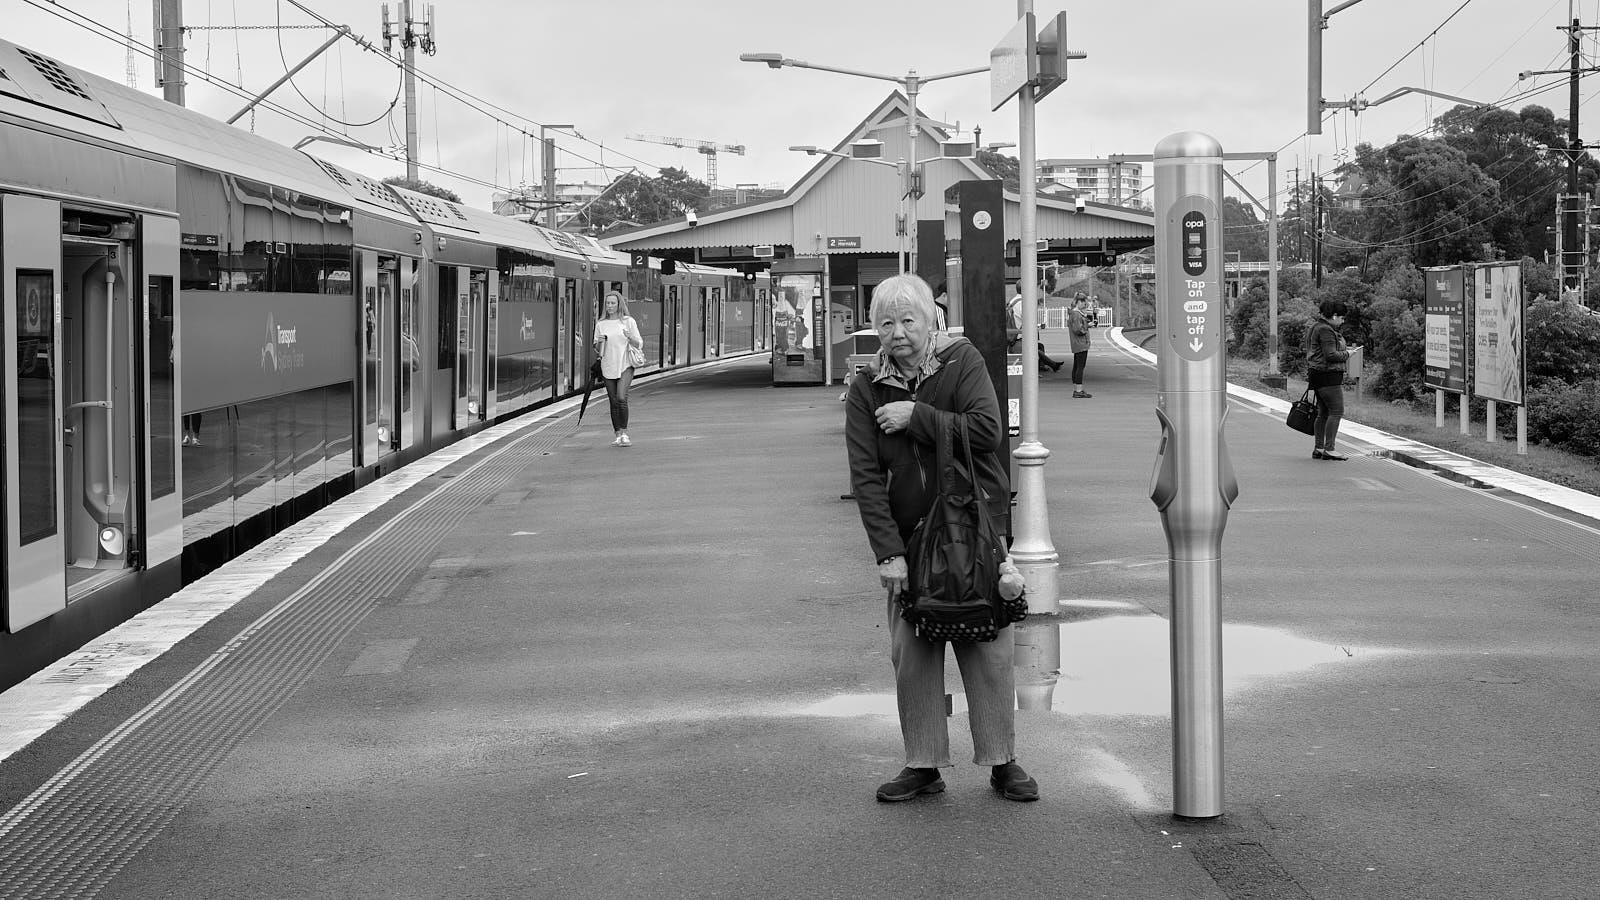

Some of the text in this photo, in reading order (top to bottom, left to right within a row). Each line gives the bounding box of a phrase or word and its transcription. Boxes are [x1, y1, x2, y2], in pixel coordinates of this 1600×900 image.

[1185, 220, 1203, 229] opal
[830, 239, 836, 247] 2
[110, 251, 116, 259] 3
[636, 255, 643, 265] 2
[1185, 279, 1206, 290] Tap
[1188, 289, 1203, 297] on
[1187, 303, 1204, 311] and
[1186, 315, 1206, 325] tap
[1188, 325, 1205, 335] off
[277, 325, 296, 348] Transport
